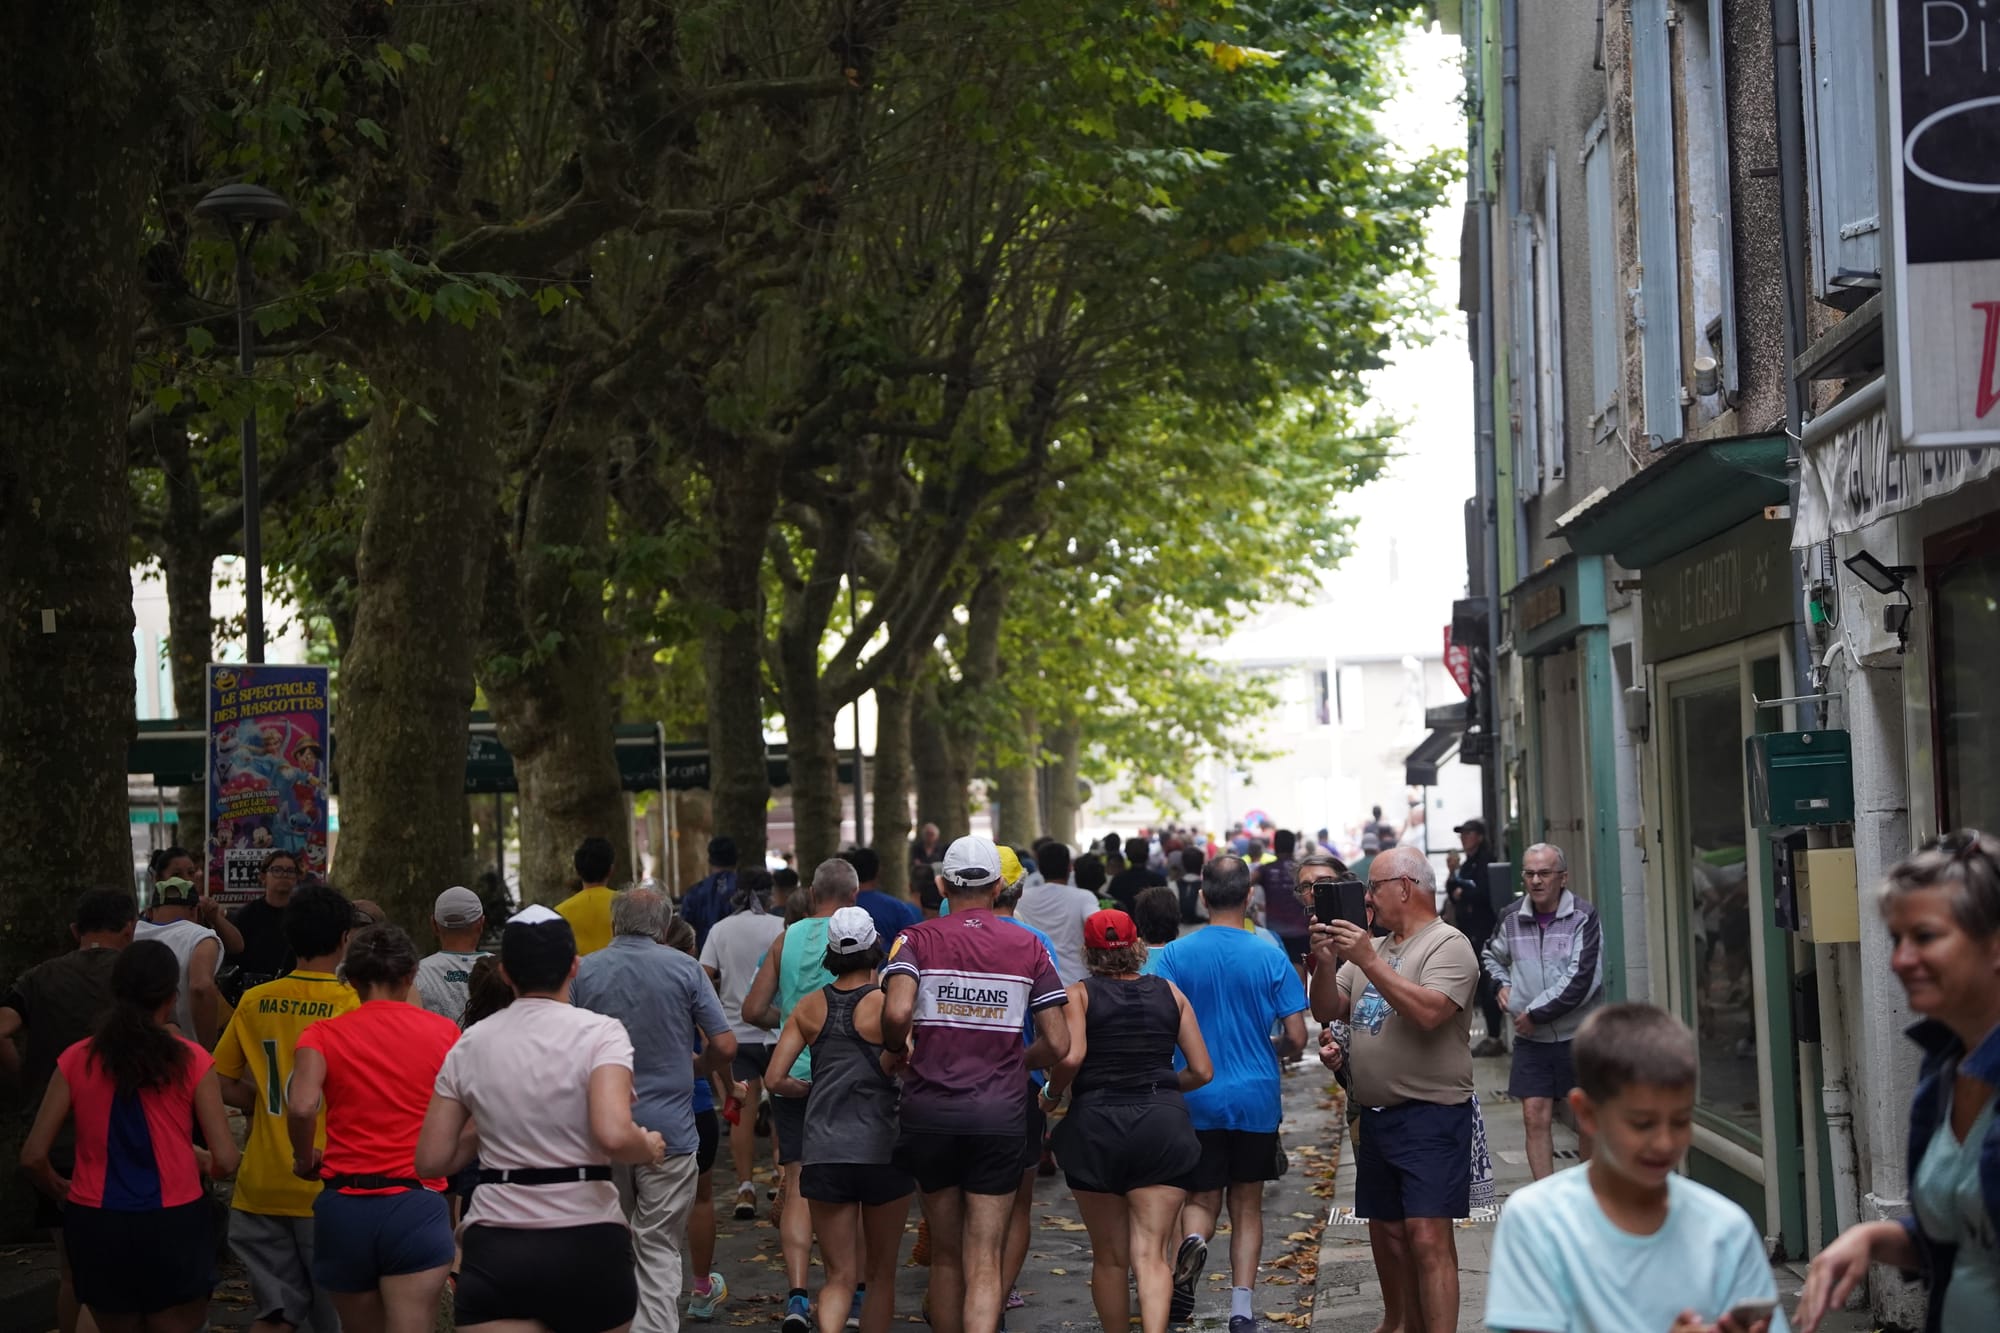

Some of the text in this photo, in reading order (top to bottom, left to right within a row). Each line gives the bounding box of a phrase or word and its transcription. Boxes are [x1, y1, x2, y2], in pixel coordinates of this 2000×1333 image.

[1922, 0, 2000, 77] Pi
[1849, 414, 1909, 517] GLCIER
[1679, 567, 1692, 632] LE
[220, 681, 317, 707] LE SPECTACLE
[214, 697, 324, 724] DES MASCOTTES
[230, 867, 250, 881] 11
[938, 982, 1008, 1004] PÉLICANS
[259, 999, 334, 1018] MASTADRI
[937, 1002, 1007, 1020] ROSEMONT
